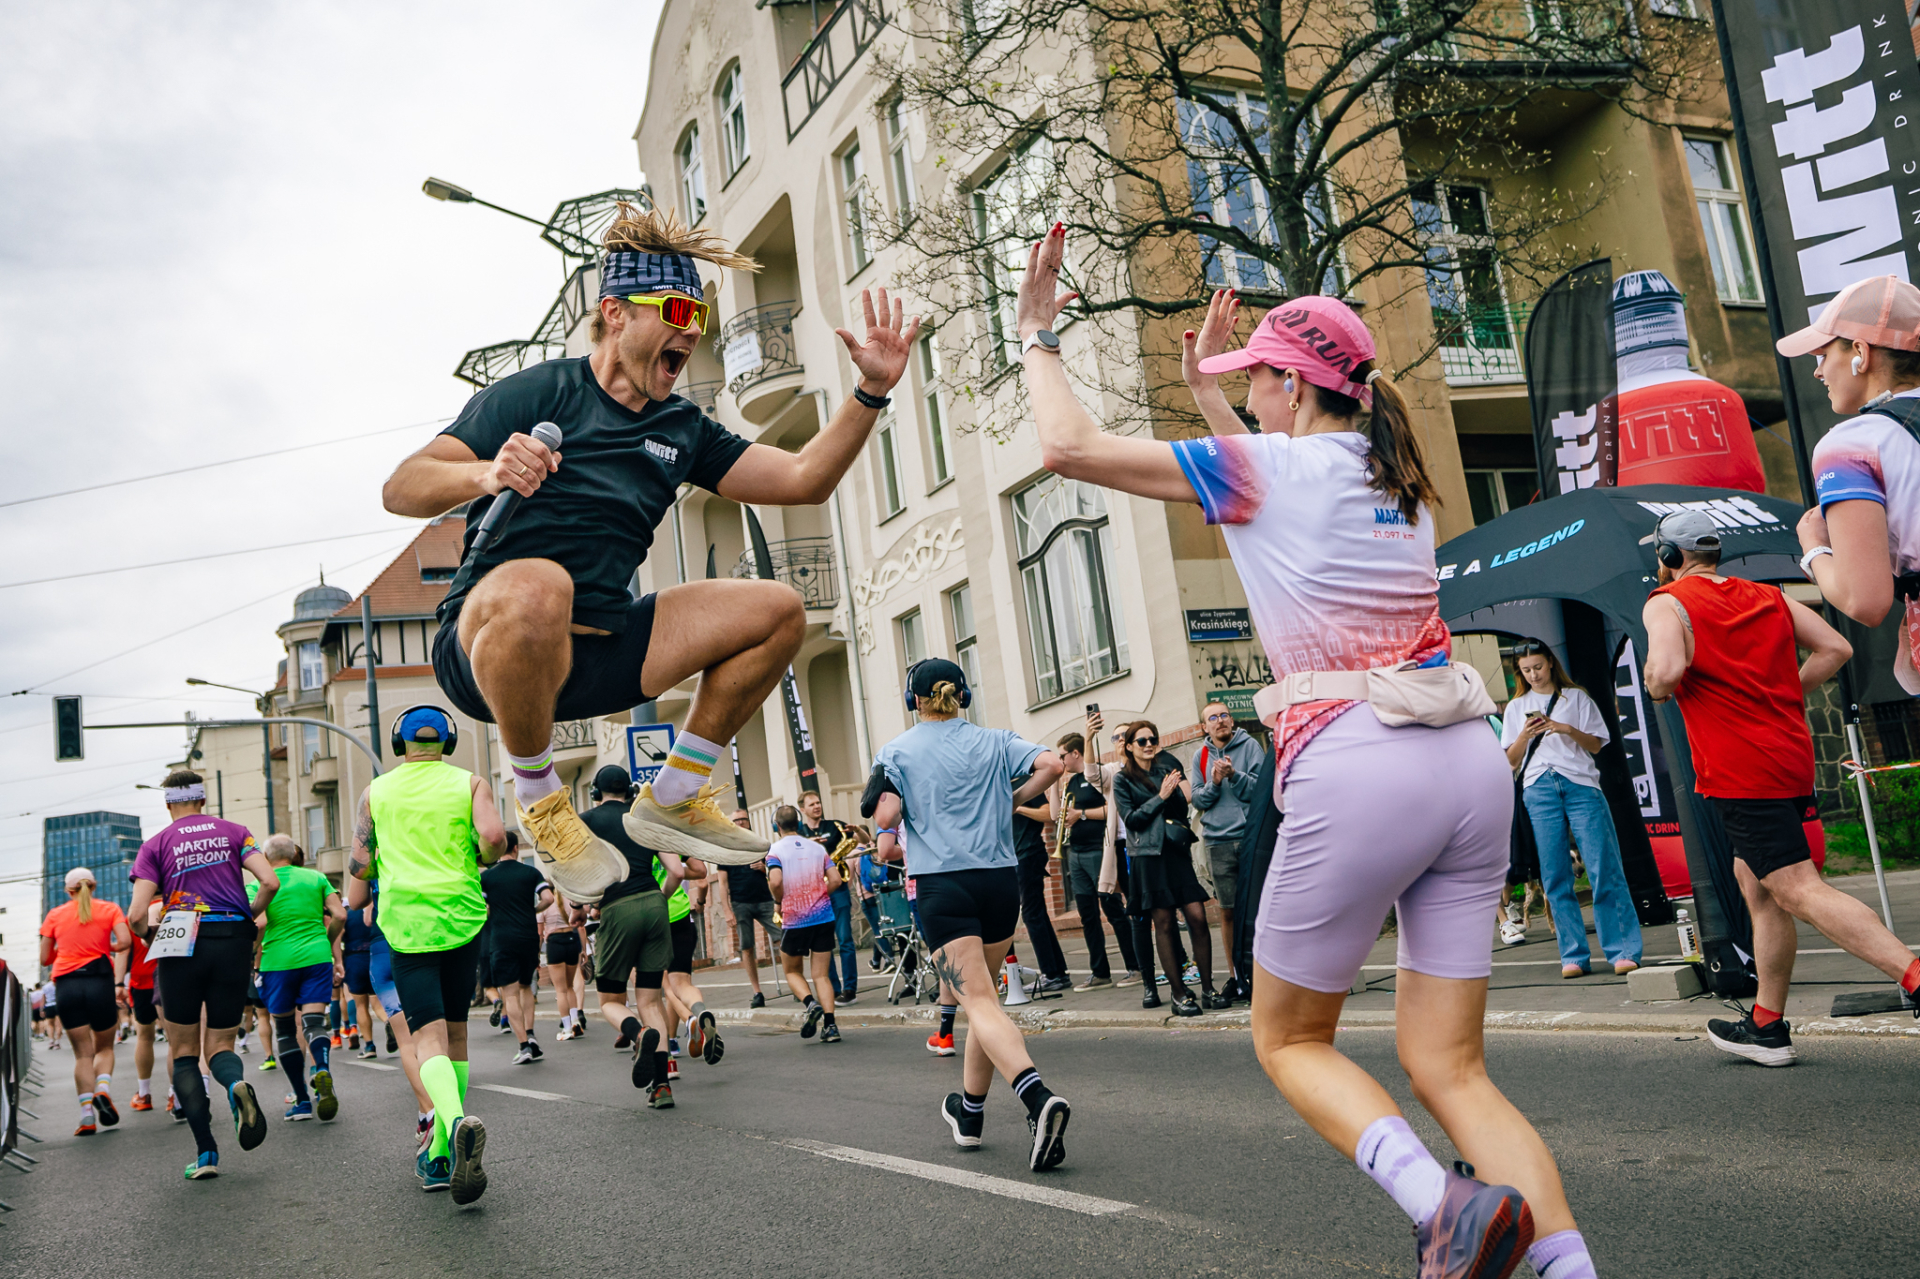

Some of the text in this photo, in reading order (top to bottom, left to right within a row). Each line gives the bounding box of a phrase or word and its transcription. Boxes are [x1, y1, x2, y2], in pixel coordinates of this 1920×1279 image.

[1872, 13, 1908, 128] DRINK
[1602, 401, 1614, 461] DRINK
[1374, 507, 1410, 526] MART
[1403, 532, 1416, 540] km
[1747, 524, 1789, 534] DRINK
[1462, 559, 1481, 577] A
[1489, 518, 1586, 569] LEGEND
[1190, 619, 1249, 630] Krasińskiego
[178, 822, 216, 835] TOMEK
[1655, 822, 1681, 834] DRIN
[173, 837, 230, 857] WARTKIE
[175, 850, 231, 871] PIERONY
